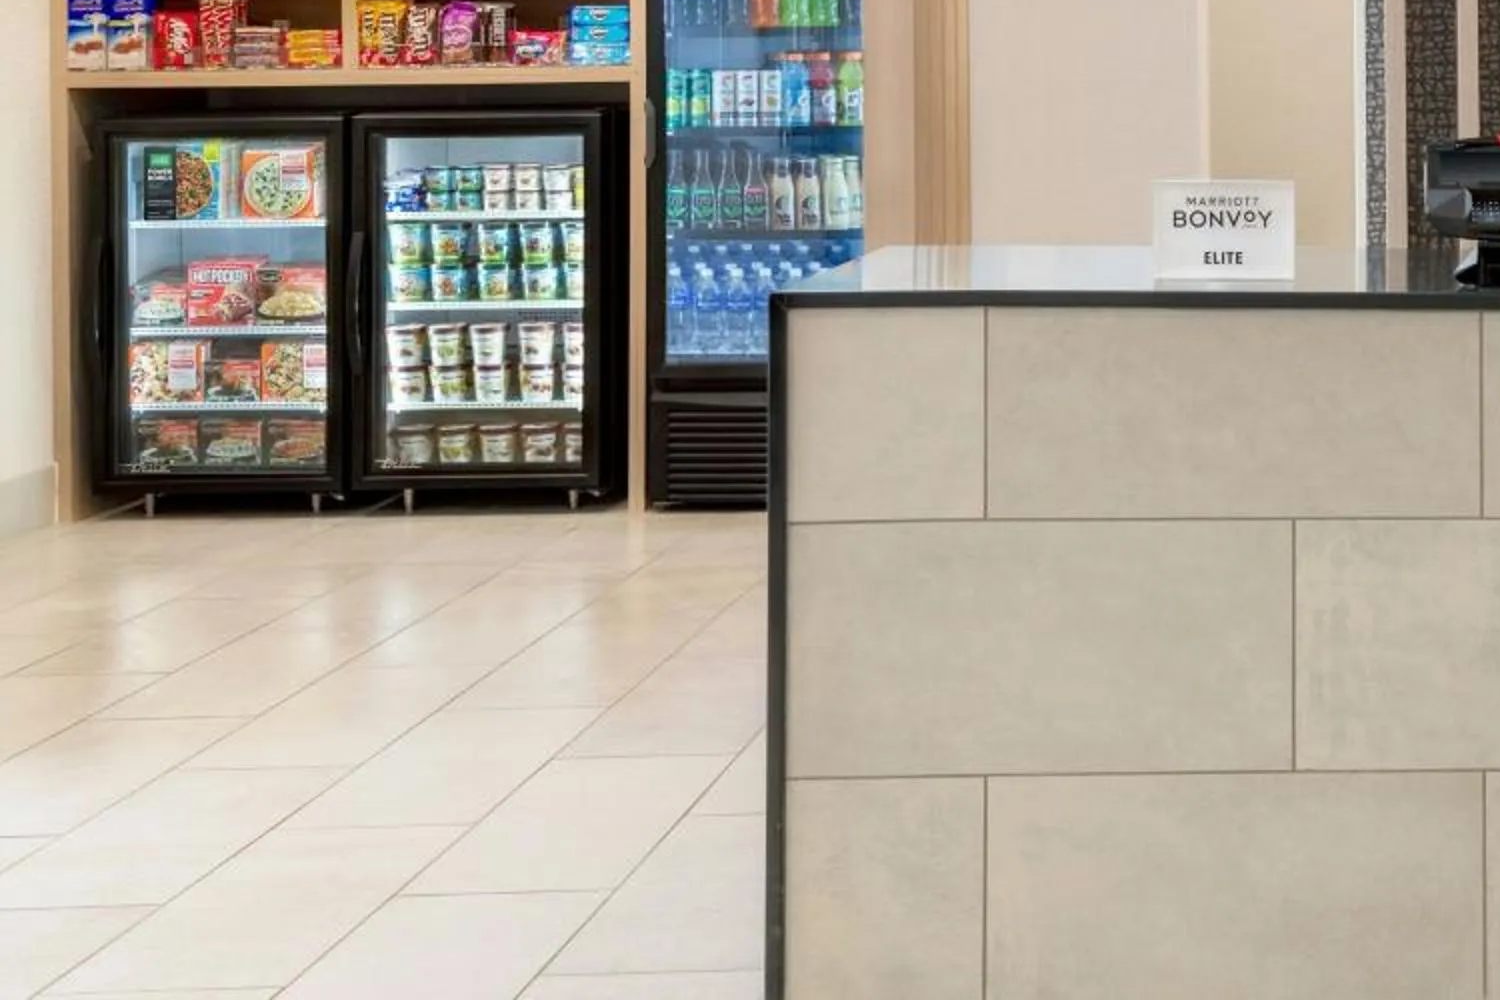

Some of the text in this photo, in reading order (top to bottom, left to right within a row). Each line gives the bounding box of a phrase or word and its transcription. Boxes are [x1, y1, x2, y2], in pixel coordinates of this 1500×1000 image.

[1186, 196, 1259, 207] MARRIOTT
[1172, 210, 1273, 228] BONVOY
[1203, 251, 1243, 265] ELITE
